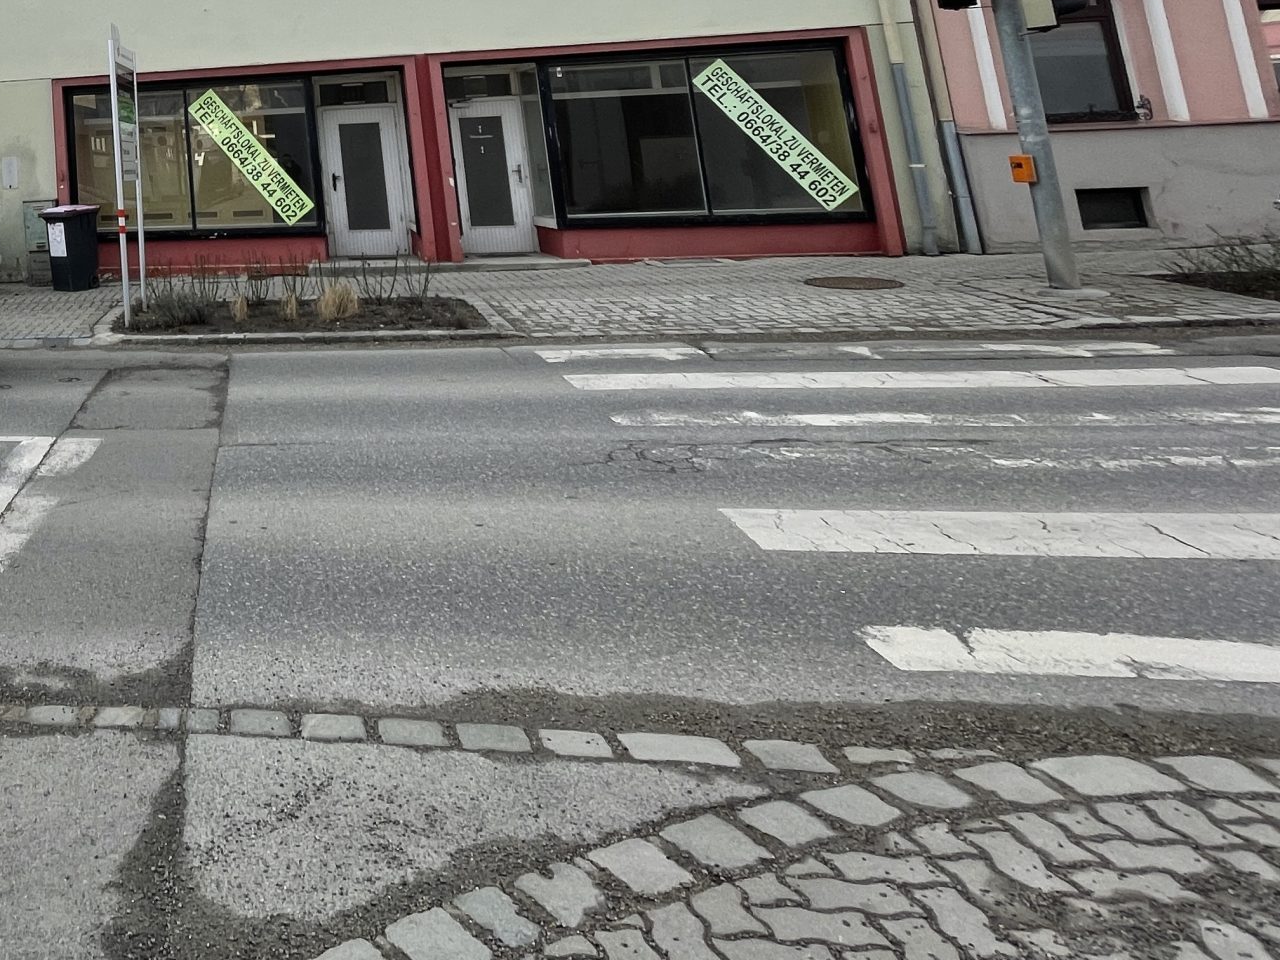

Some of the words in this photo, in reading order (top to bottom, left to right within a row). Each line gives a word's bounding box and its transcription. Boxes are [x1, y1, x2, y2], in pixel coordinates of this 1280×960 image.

[202, 95, 261, 161] GESCHÄFTSLOKAL
[259, 157, 272, 172] ZU
[268, 167, 309, 213] VERMIETEN
[221, 136, 263, 182] 0664/38
[260, 181, 278, 198] 44
[275, 198, 298, 222] 602
[700, 74, 737, 113] TEL.:
[736, 111, 791, 162] 0664/38
[789, 162, 809, 180] 44
[808, 179, 838, 207] 602
[711, 66, 787, 141] GESCHÄFTSLOKAL
[783, 135, 800, 151] ZU
[796, 146, 850, 197] VERMIETEN
